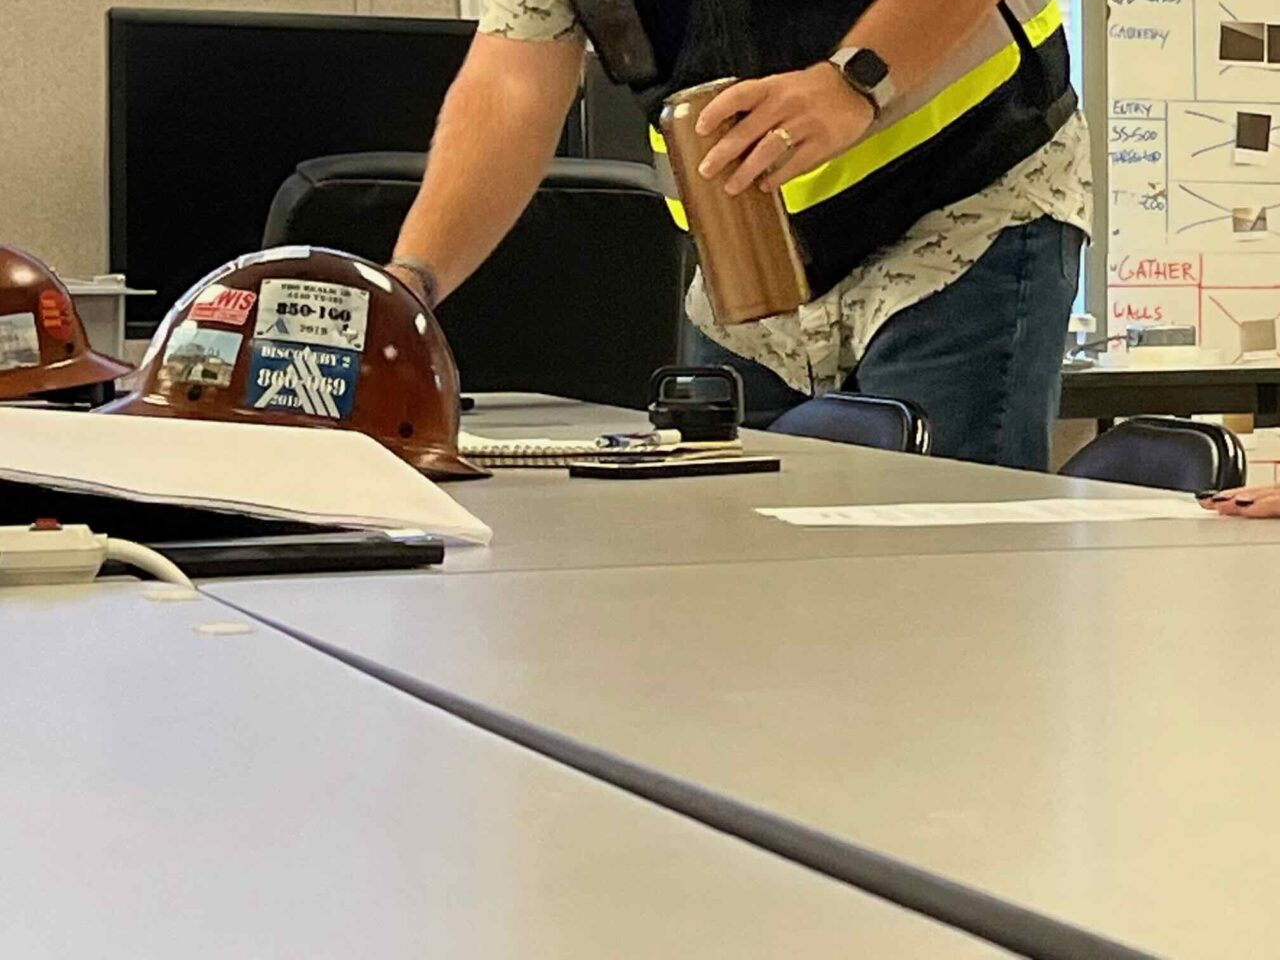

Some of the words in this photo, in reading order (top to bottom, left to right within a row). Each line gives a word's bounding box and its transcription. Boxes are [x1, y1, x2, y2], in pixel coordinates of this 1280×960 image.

[1112, 100, 1153, 118] ENTRY
[1117, 255, 1197, 281] GATHER
[1113, 301, 1163, 321] WALLS
[341, 355, 351, 369] 2
